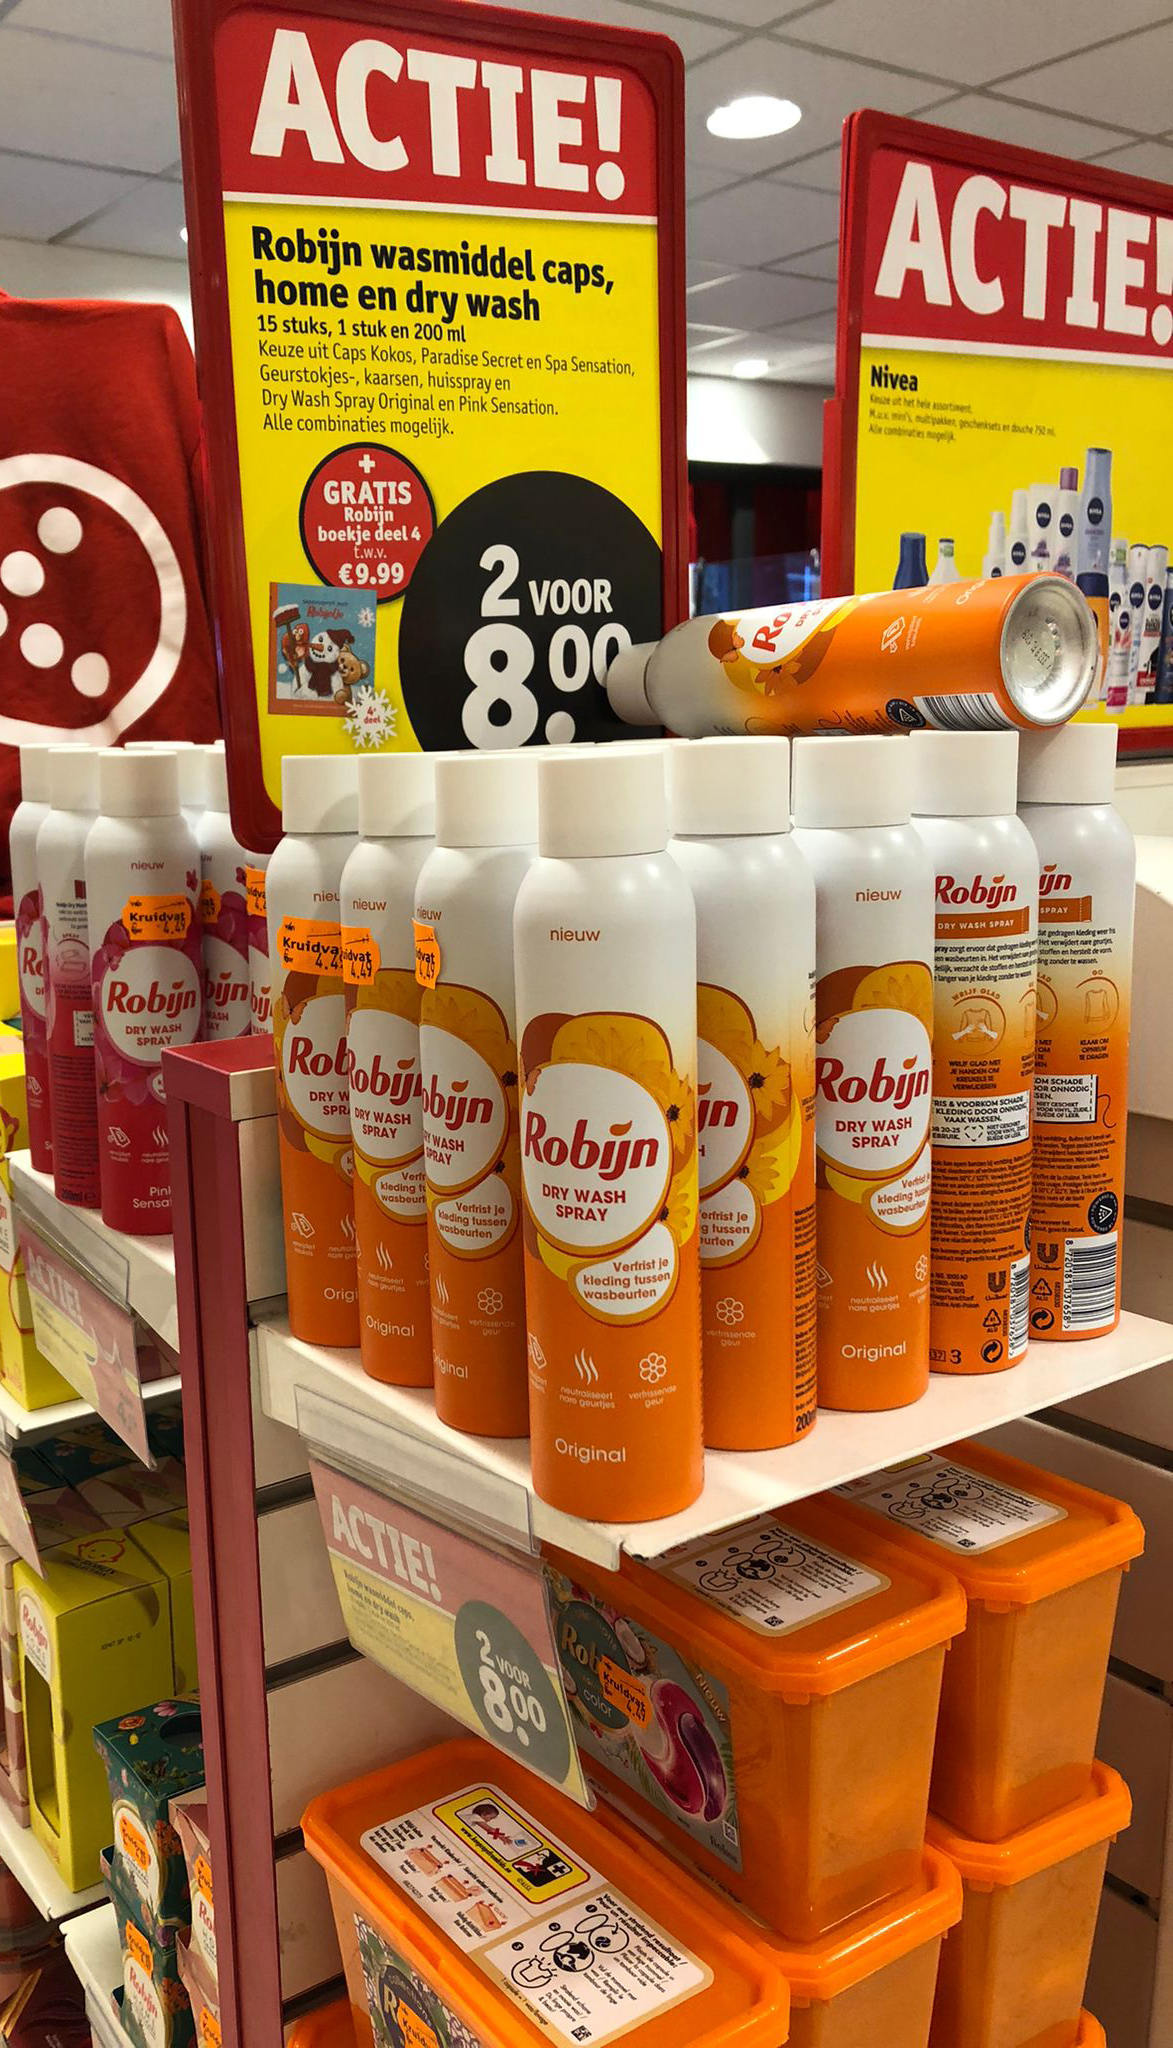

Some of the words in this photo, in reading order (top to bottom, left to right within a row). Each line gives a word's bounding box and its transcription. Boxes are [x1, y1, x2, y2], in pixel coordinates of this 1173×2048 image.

[250, 28, 625, 201] ACTIE!
[252, 226, 362, 275] Robijn
[370, 240, 536, 282] wasmiddel
[542, 259, 614, 295] caps,
[874, 161, 1173, 346] ACTIE!
[254, 269, 349, 309] home
[358, 284, 397, 311] en
[406, 280, 458, 324] dry
[466, 289, 540, 321] wash
[257, 315, 277, 332] 15
[282, 316, 332, 337] stuks,
[338, 319, 347, 335] 1
[352, 320, 387, 337] stuk
[391, 324, 409, 339] en
[414, 323, 443, 340] 200
[447, 325, 466, 342] ml
[259, 340, 304, 358] Keuze
[308, 342, 329, 359] uit
[333, 343, 366, 364] Caps
[371, 345, 417, 365] Kokos,
[421, 347, 478, 367] Paradise
[482, 351, 524, 369] Secret
[526, 357, 541, 370] en
[545, 355, 567, 375] Spa
[571, 356, 635, 377] Sensation,
[260, 364, 359, 388] Geurstokjes-,
[364, 368, 423, 389] kaarsen,
[428, 371, 492, 394] huisspray
[495, 378, 511, 391] en
[871, 365, 918, 391] Nivea
[262, 389, 287, 410] Dry
[291, 389, 330, 407] Wash
[334, 391, 375, 412] Spray
[378, 392, 435, 414] Original
[438, 399, 454, 412] en
[459, 396, 487, 413] Pink
[491, 397, 559, 416] Sensation.
[903, 396, 914, 407] het
[263, 413, 293, 430] Alle
[297, 415, 386, 433] combinaties
[390, 418, 454, 438] mogelijk.
[884, 426, 924, 439] combinaties
[323, 480, 412, 505] GRATIS
[344, 506, 394, 526] Robijn
[318, 525, 371, 545] boekje
[374, 525, 408, 541] deel
[411, 526, 421, 541] 4
[354, 546, 387, 559] t.w.v.
[479, 545, 520, 617] 2
[529, 579, 614, 616] VOOR
[131, 861, 164, 870] nieuw
[855, 889, 902, 902] nieuw
[935, 875, 1017, 909] Robijn
[352, 899, 387, 910] nieuw
[130, 911, 187, 923] Kruidvat
[416, 908, 442, 921] nieuw
[163, 921, 186, 935] 4.49
[959, 921, 986, 929] WASH
[989, 919, 1014, 928] SPRAY
[550, 927, 600, 942] nieuw
[282, 937, 342, 955] Kruidva
[351, 961, 372, 978] 4.49
[419, 964, 436, 979] 4.49
[203, 970, 248, 1007] bijn
[107, 980, 197, 1018] Robijn
[125, 1025, 146, 1034] DRY
[150, 1023, 182, 1034] WASH
[137, 1036, 172, 1046] SPRAY
[289, 1036, 349, 1077] Rob
[816, 1055, 929, 1109] Robijn
[309, 1091, 336, 1102] DRY
[999, 1096, 1023, 1105] SCHADE
[355, 1108, 370, 1121] DRY
[372, 1110, 411, 1125] WASH
[967, 1115, 1002, 1123] WASSEN.
[974, 1107, 998, 1115] DOOR
[362, 1124, 397, 1139] SPRAY
[835, 1119, 865, 1132] DRY
[872, 1117, 912, 1131] WASH
[432, 1134, 465, 1152] WASH
[524, 1110, 659, 1181] Robijn
[852, 1134, 900, 1148] SPRAY
[426, 1147, 452, 1165] SPRAY
[380, 1182, 416, 1194] kleding
[542, 1184, 568, 1201] DRY
[574, 1189, 626, 1204] WASH
[133, 1197, 172, 1209] Sensa
[877, 1191, 913, 1204] kleding
[455, 1201, 491, 1214] Verfrist
[494, 1203, 505, 1216] je
[556, 1205, 608, 1222] SPRAY
[877, 1200, 926, 1216] wasbeurten
[438, 1210, 470, 1226] kleding
[472, 1217, 507, 1227] tussen
[736, 1211, 748, 1223] je
[439, 1223, 492, 1239] wasbeurten
[712, 1223, 750, 1234] tussen
[612, 1259, 656, 1273] Verfrist
[658, 1258, 669, 1271] je
[583, 1274, 630, 1288] kleding
[634, 1272, 670, 1285] tussen
[324, 1287, 358, 1303] Origi
[584, 1289, 656, 1300] wasbeurten
[850, 1294, 899, 1305] neutraliseert
[848, 1303, 867, 1312] nare
[869, 1303, 900, 1313] geurtjes
[366, 1314, 415, 1337] Original
[841, 1341, 907, 1362] Original
[950, 1350, 961, 1364] 3
[560, 1385, 613, 1400] neutraliseert
[628, 1385, 676, 1400] verfrissende
[579, 1398, 615, 1409] geurtjes
[645, 1398, 664, 1408] geur
[555, 1438, 627, 1464] Original
[331, 1494, 442, 1602] ACTIE!
[560, 1624, 600, 1674] Rob
[475, 1630, 494, 1667] 2
[495, 1654, 532, 1691] VOOR
[603, 1670, 646, 1709] Kruidvat
[478, 1665, 547, 1747] 8.00
[582, 1688, 612, 1719] color
[626, 1700, 646, 1723] 4.49
